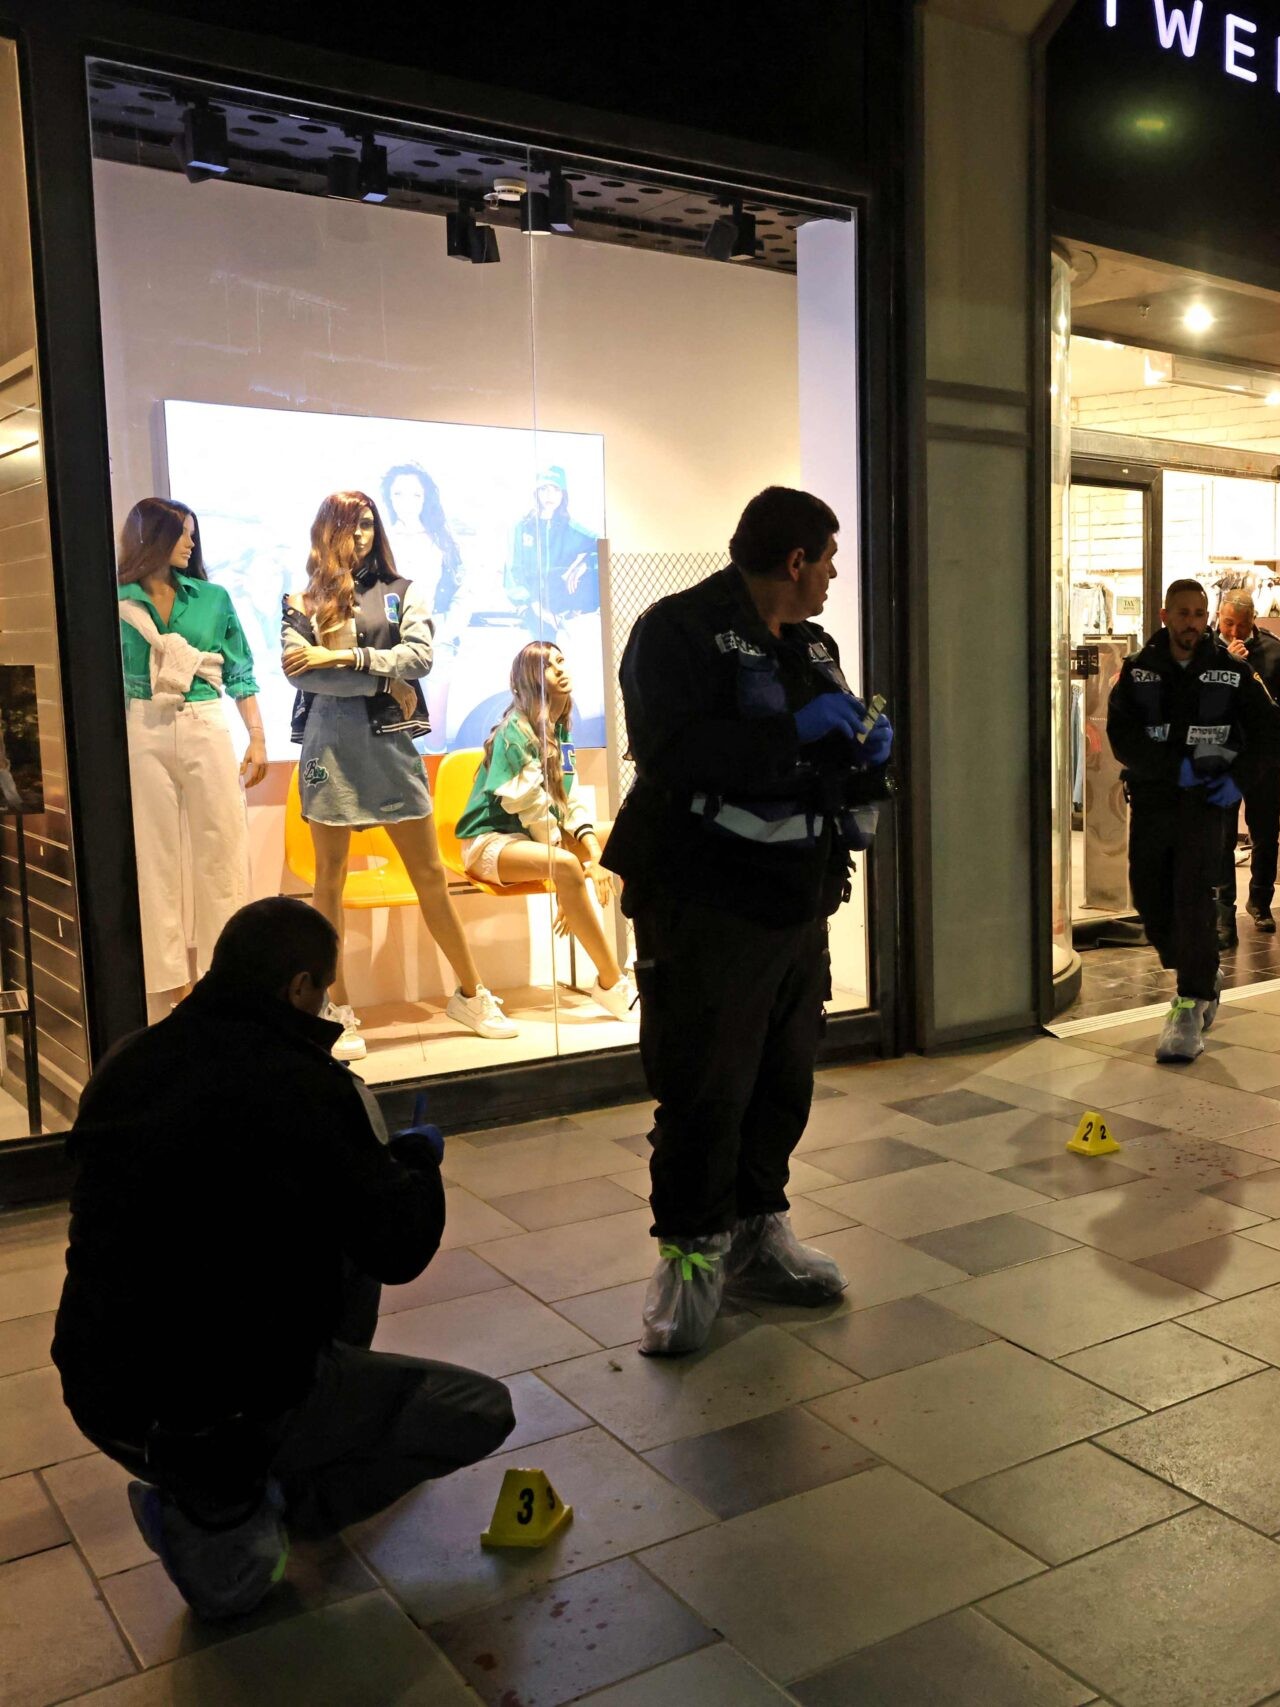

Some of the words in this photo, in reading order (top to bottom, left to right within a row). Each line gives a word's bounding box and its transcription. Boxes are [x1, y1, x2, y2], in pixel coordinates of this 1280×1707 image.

[1202, 672, 1238, 686] LICE
[1082, 1121, 1094, 1142] 2
[1100, 1124, 1107, 1140] 2
[517, 1487, 535, 1525] 3
